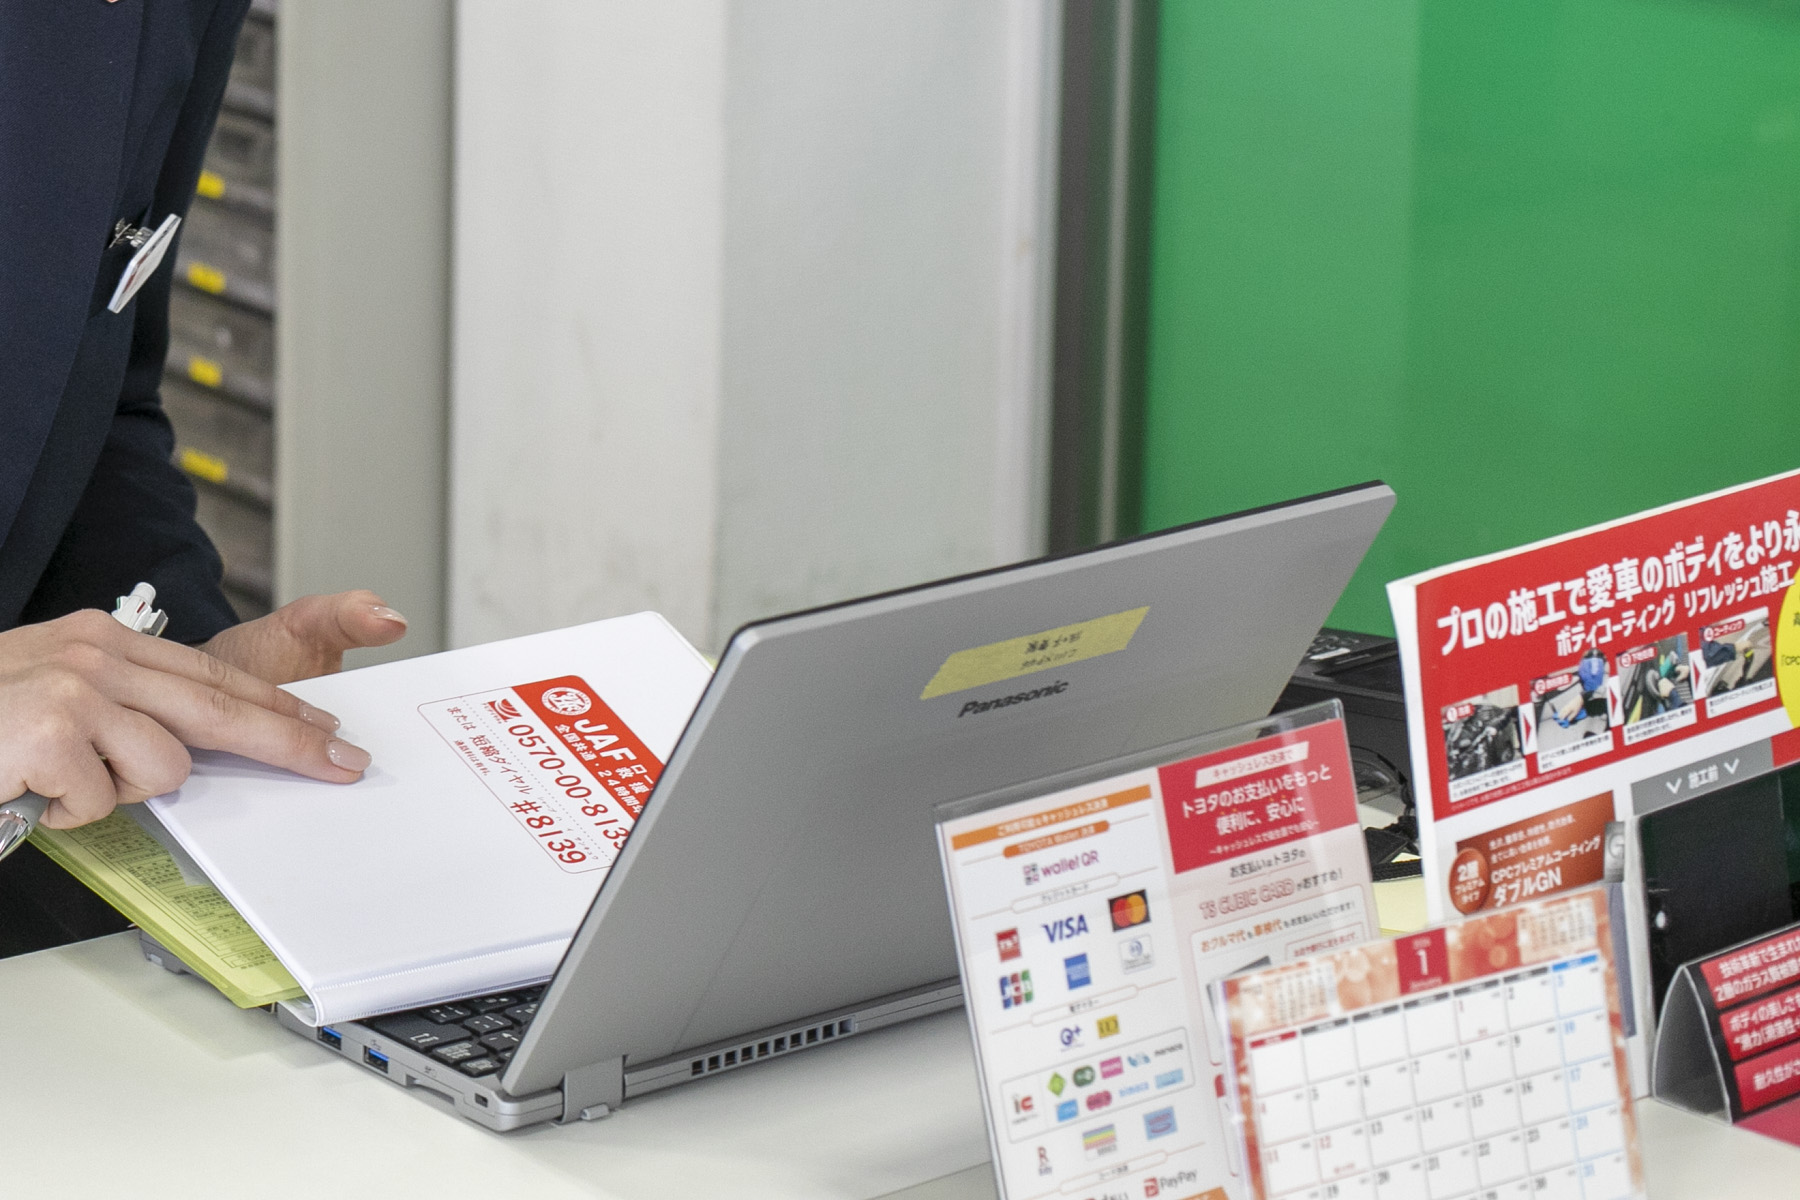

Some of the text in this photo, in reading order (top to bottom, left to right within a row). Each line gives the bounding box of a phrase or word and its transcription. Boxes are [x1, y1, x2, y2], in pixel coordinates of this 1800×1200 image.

[1556, 561, 1795, 657] ボディコーティング リフレッシュ施工
[957, 680, 1069, 718] Panasonic
[573, 718, 637, 763] JAF
[447, 707, 586, 863] または 短縮ダイヤル #8139
[1182, 764, 1332, 819] トヨタのお支払いをもっと
[1042, 850, 1099, 877] wallet QR
[1491, 835, 1601, 884] CPCプレミアムコーティング
[1259, 879, 1296, 902] CARD
[1494, 867, 1562, 907] ダブルGN
[1041, 914, 1089, 943] VISA
[1416, 949, 1428, 975] 1
[1160, 1170, 1198, 1189] PayPay
